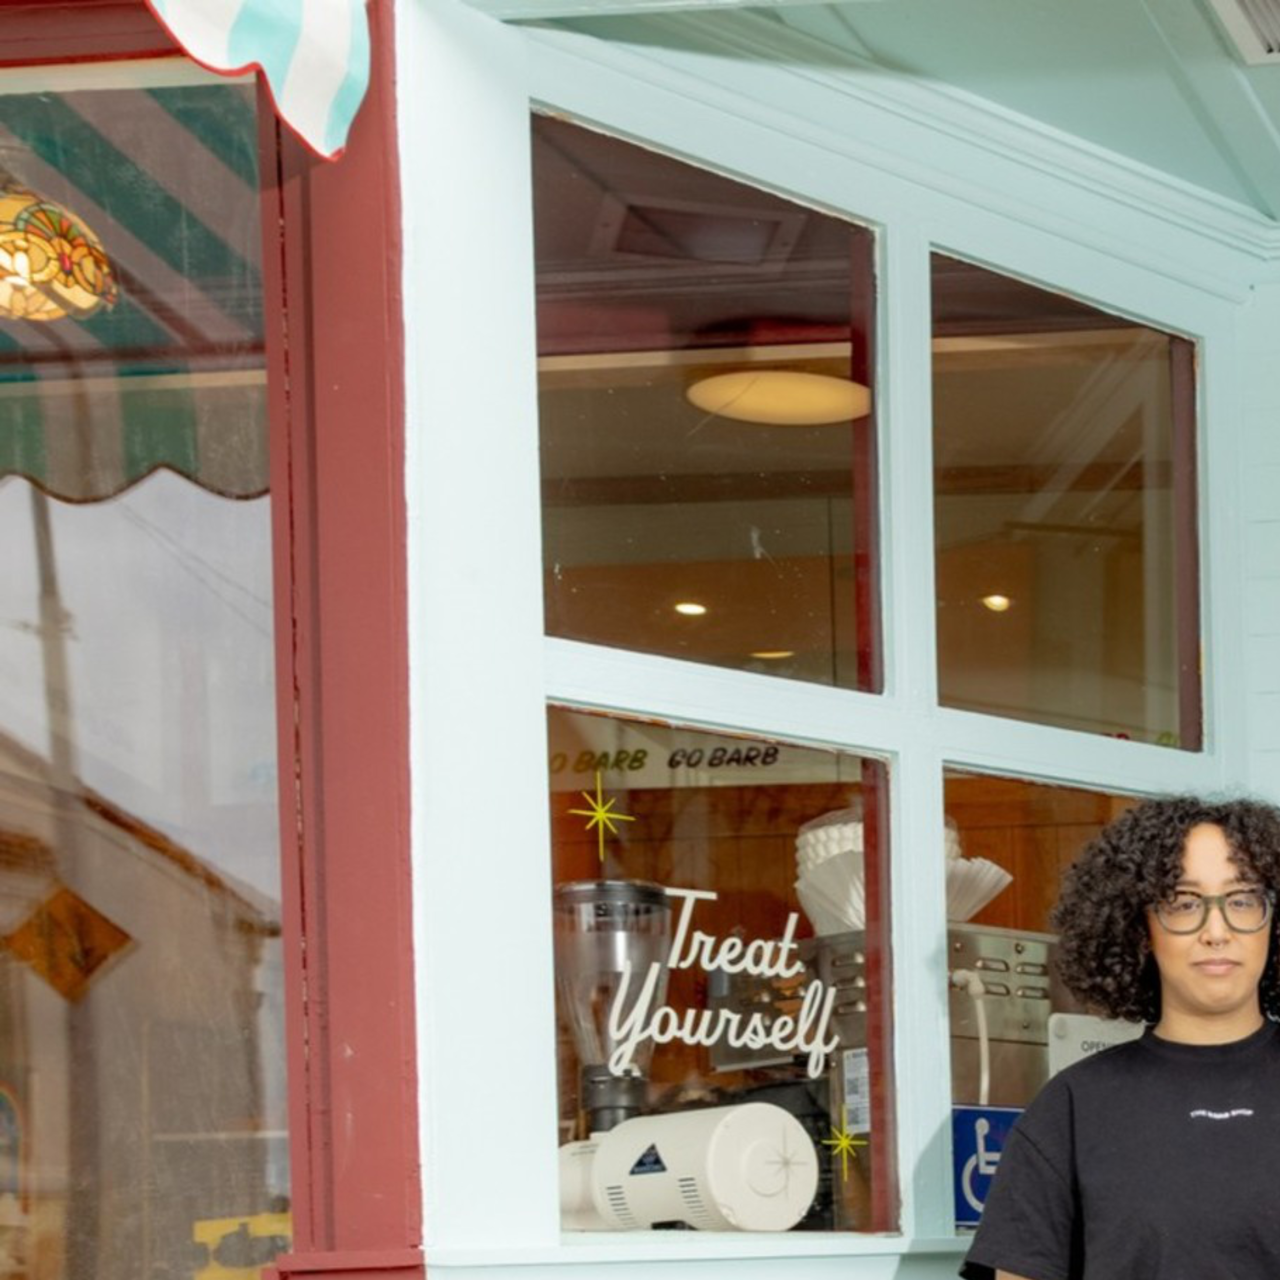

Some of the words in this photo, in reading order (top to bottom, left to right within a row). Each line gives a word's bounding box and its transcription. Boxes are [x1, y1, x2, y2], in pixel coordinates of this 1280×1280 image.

[572, 748, 648, 773] BARB
[667, 747, 703, 769] GO
[707, 746, 780, 769] BARB
[663, 887, 806, 979] Treat
[608, 959, 840, 1079] Yourself
